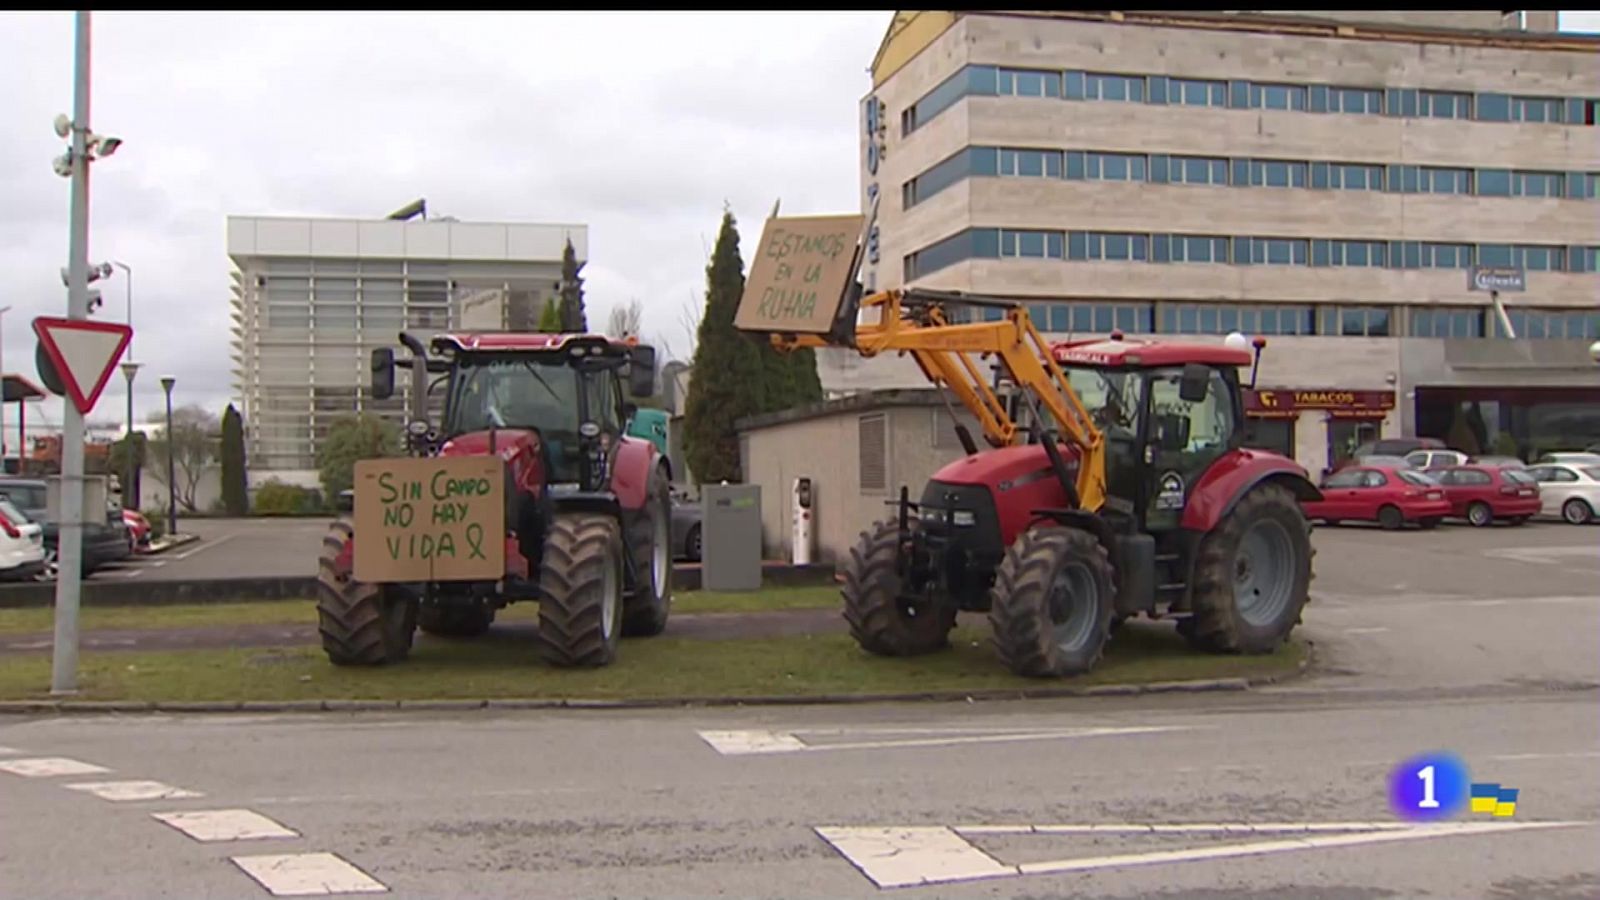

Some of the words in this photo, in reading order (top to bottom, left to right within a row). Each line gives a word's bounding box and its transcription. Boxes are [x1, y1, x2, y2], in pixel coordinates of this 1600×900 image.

[766, 228, 846, 260] ESTAMOS
[774, 262, 793, 281] EN
[803, 263, 823, 283] LA
[1294, 392, 1355, 403] TABACOS
[384, 503, 414, 528] NO
[432, 502, 469, 525] HAY
[386, 532, 456, 561] VIDA
